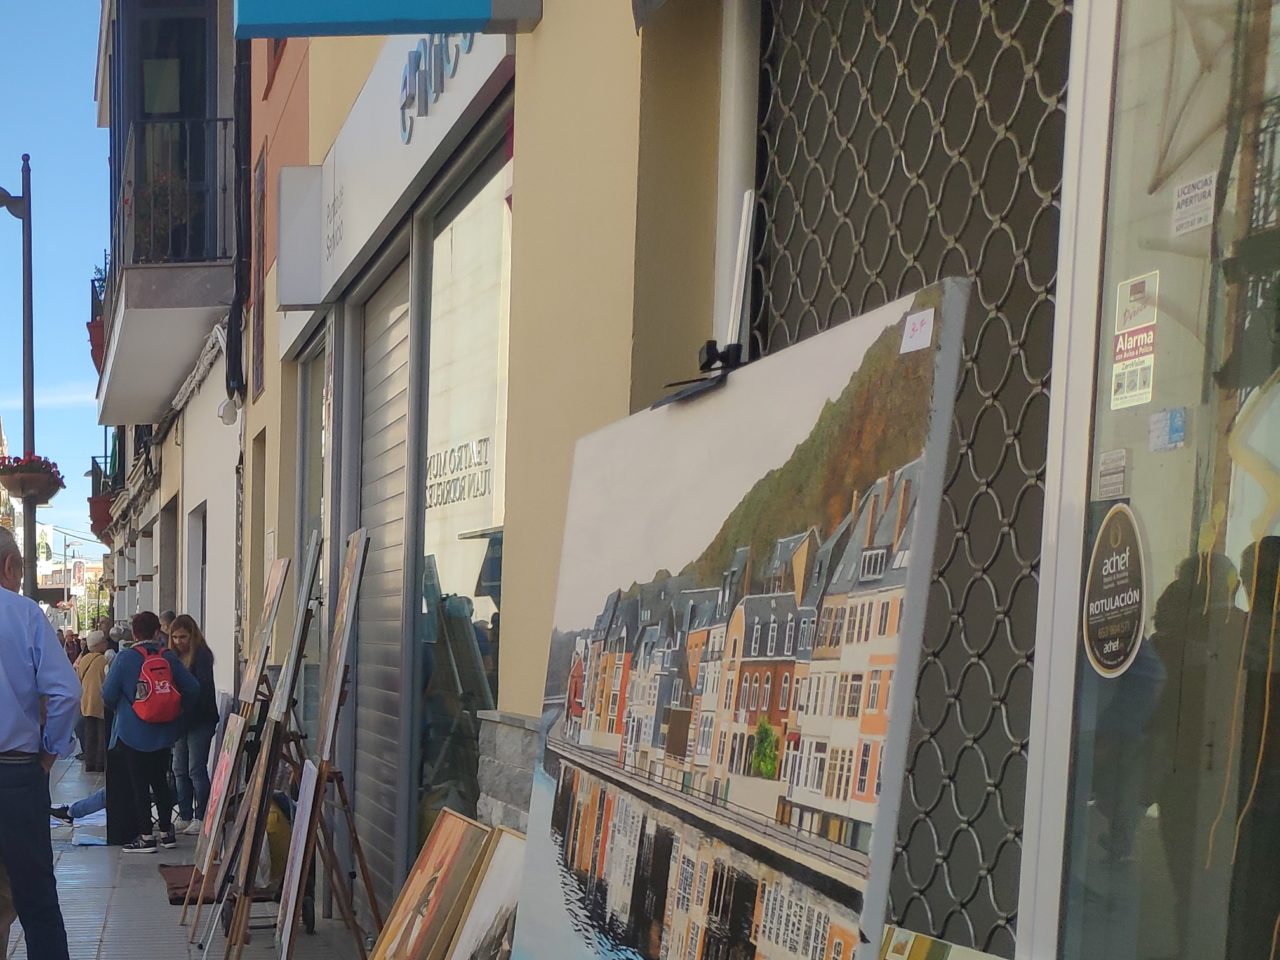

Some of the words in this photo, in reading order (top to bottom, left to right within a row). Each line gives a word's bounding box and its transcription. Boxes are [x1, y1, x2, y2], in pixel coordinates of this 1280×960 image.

[1177, 175, 1213, 199] LICENCIAS
[1175, 189, 1212, 211] APERTURA
[1115, 330, 1154, 353] Alarma
[1102, 546, 1130, 576] achef
[1089, 587, 1140, 616] ROTULACIÓN
